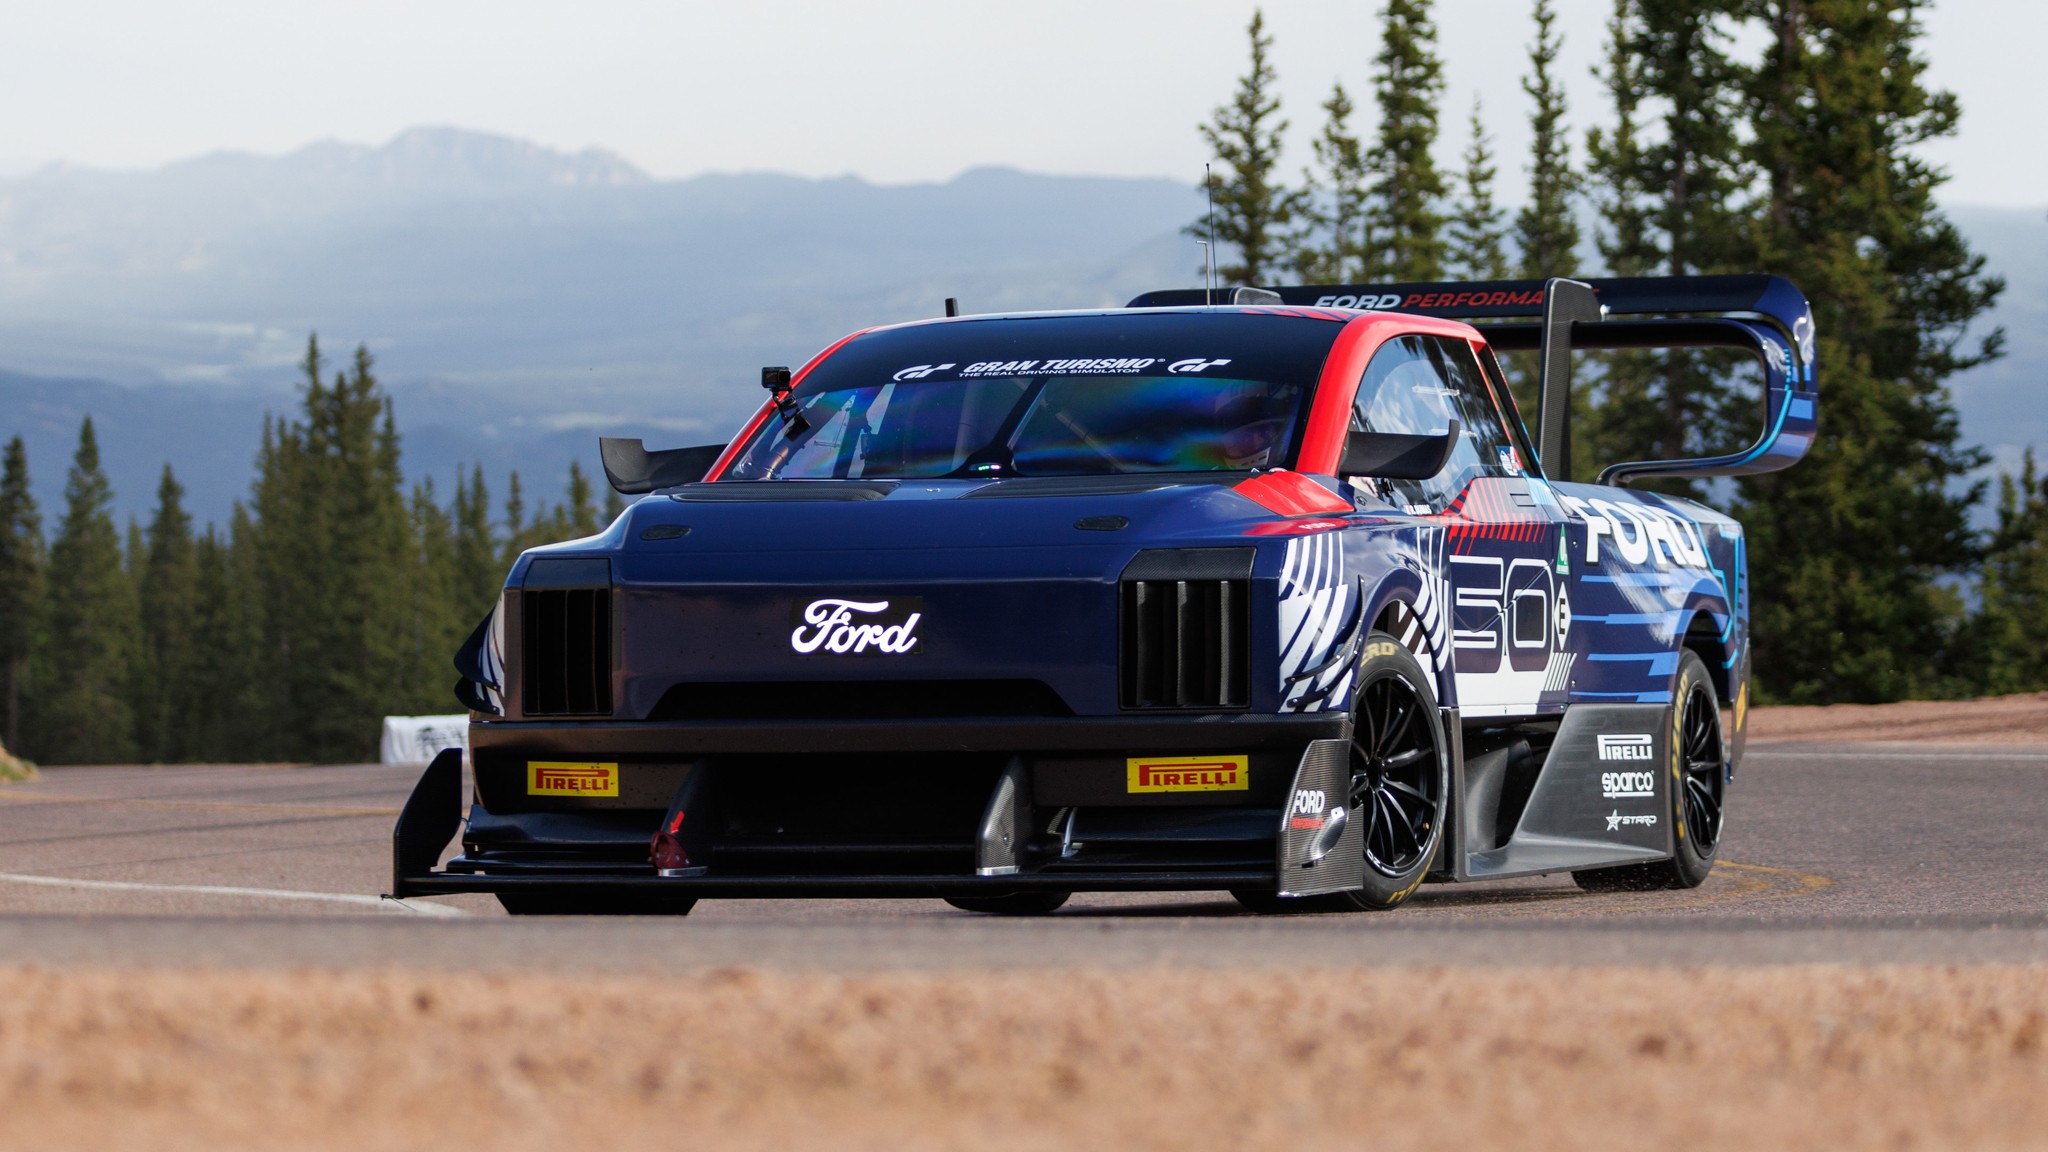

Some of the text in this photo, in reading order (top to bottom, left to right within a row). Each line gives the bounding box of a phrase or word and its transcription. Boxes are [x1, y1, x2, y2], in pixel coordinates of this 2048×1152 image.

[1314, 288, 1599, 309] FORD PERFORMA
[963, 358, 1156, 373] GRAN TURISMO
[1017, 368, 1067, 376] DRIVING
[1559, 494, 1707, 569] FORD
[792, 599, 922, 653] Ford
[1449, 554, 1555, 675] 50
[1559, 597, 1566, 635] E
[1597, 733, 1654, 760] PIRELLI
[535, 768, 610, 791] PIRELLI
[1138, 762, 1238, 787] PIRELLI
[1601, 771, 1655, 799] sparco
[1293, 790, 1325, 813] FORD
